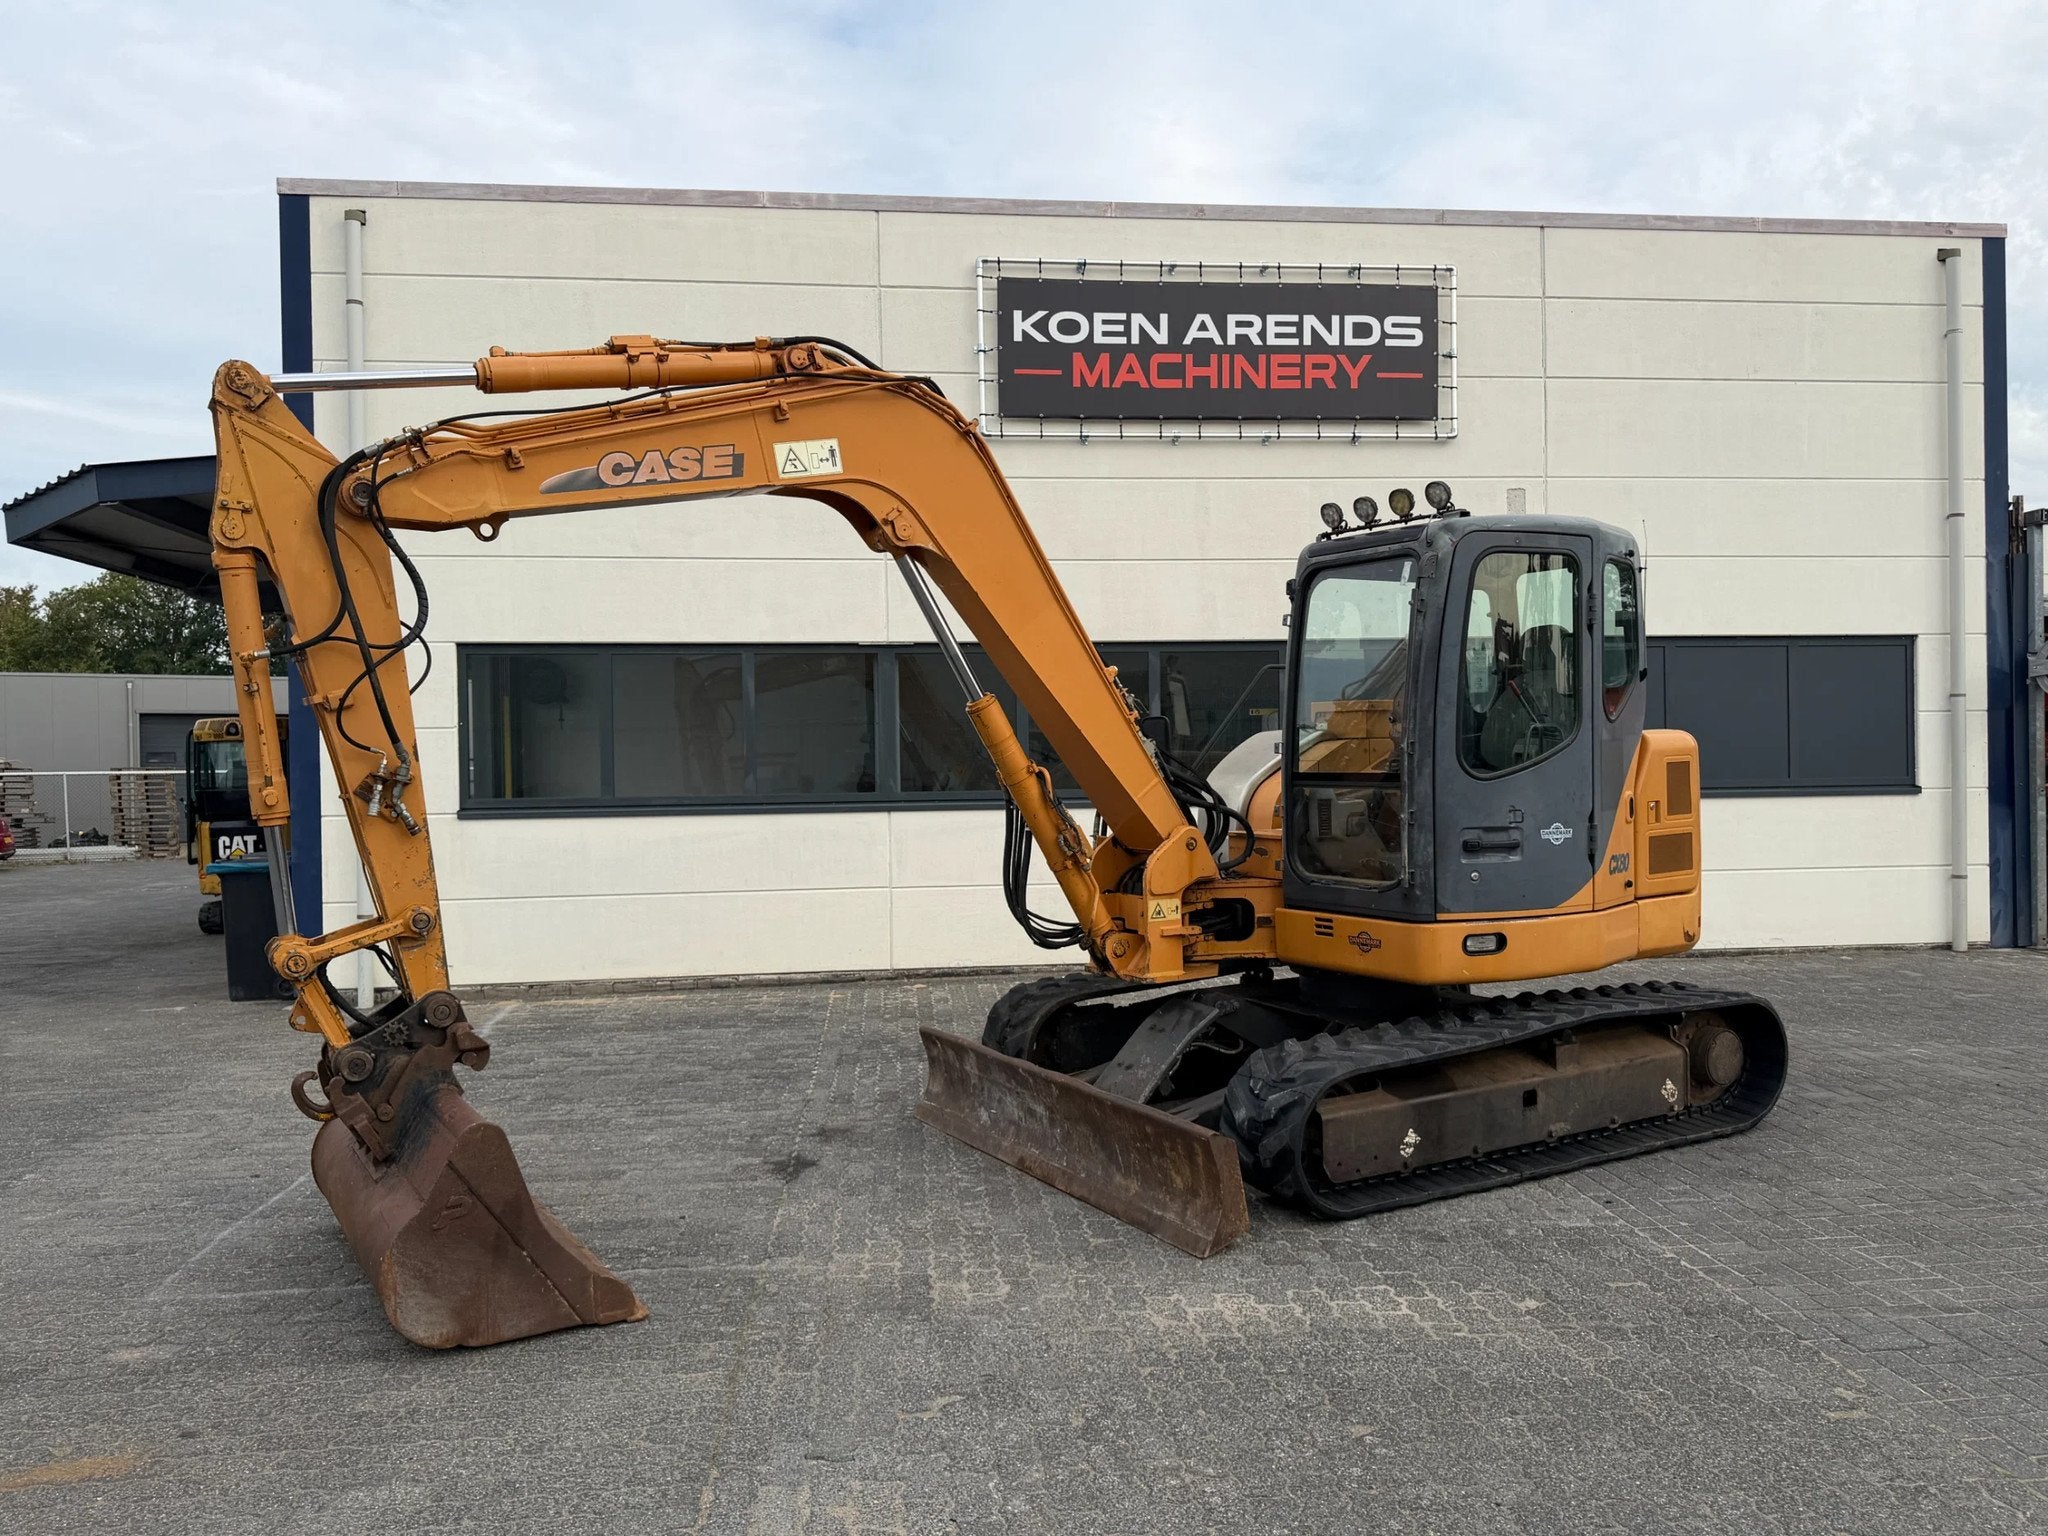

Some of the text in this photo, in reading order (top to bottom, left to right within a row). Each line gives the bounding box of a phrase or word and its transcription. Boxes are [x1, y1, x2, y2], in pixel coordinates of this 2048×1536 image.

[1012, 309, 1424, 348] KOEN ARENDS
[1072, 352, 1373, 390] MACHINERY
[596, 443, 736, 488] CASE
[217, 835, 258, 859] CAT
